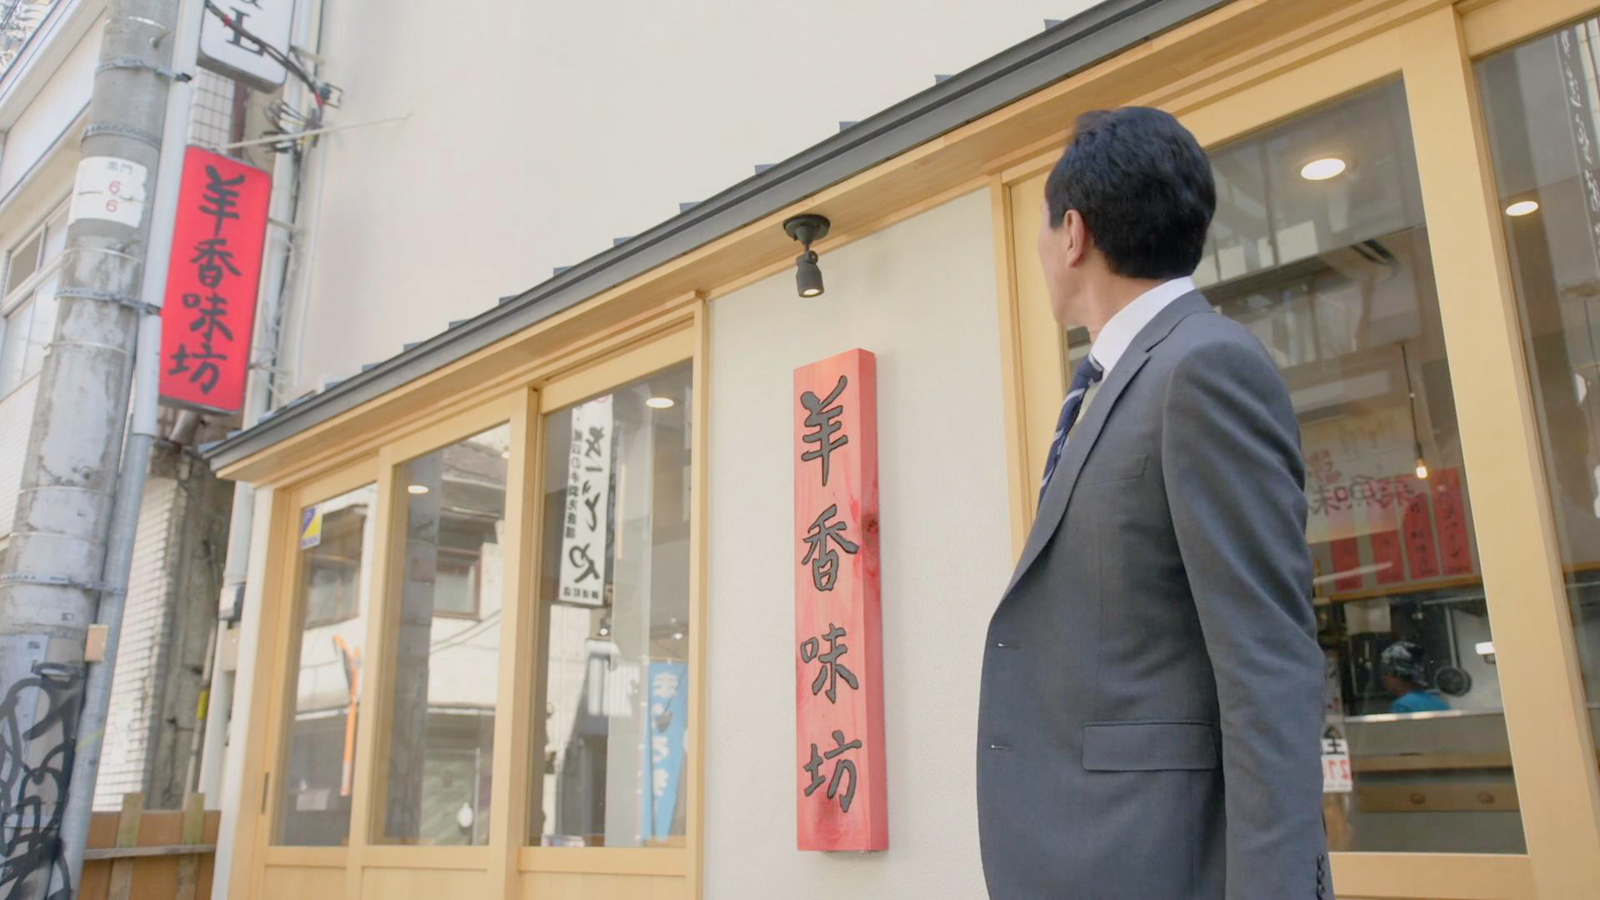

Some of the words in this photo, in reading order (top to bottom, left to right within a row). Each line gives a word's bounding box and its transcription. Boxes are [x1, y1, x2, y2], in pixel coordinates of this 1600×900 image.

[106, 200, 118, 212] 6
[109, 181, 121, 194] 6
[168, 166, 245, 394] 羊香味坊
[800, 375, 862, 813] 羊香味坊
